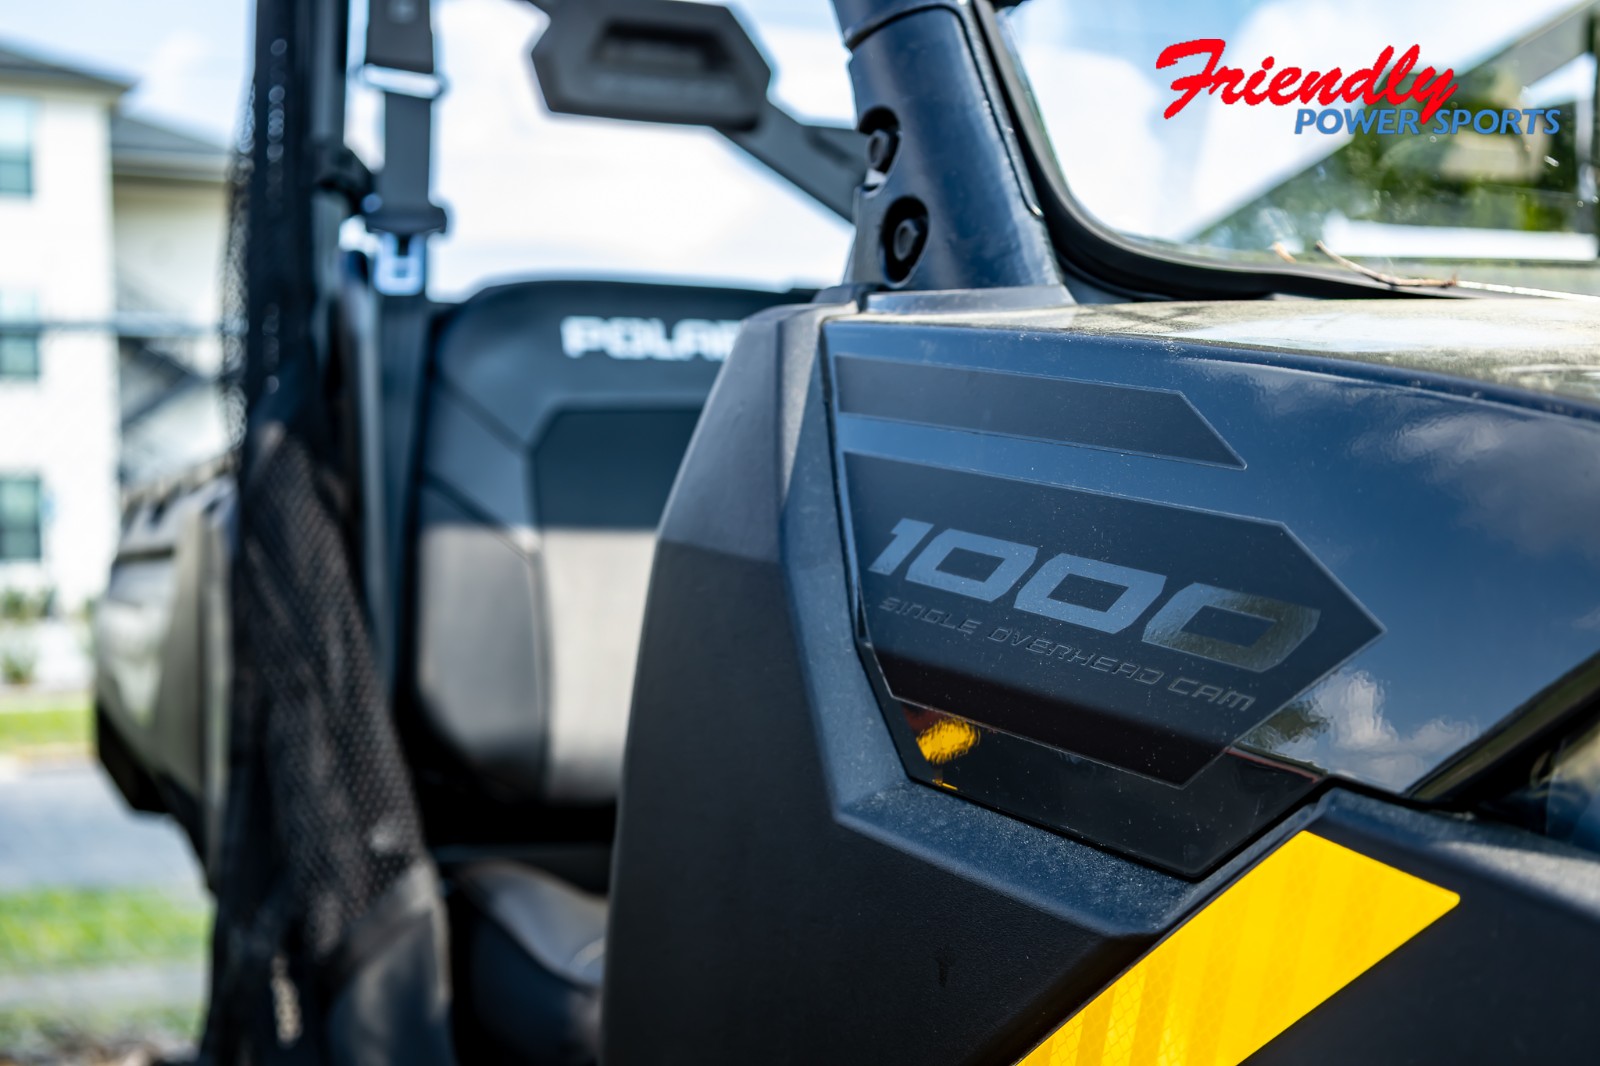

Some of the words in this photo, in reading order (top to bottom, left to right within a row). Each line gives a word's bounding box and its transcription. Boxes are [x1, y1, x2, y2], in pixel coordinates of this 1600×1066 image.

[868, 517, 1321, 673] 1000
[879, 596, 983, 635] SINGLE
[986, 627, 1165, 685] OVERHEAD
[1167, 677, 1257, 712] CAM
